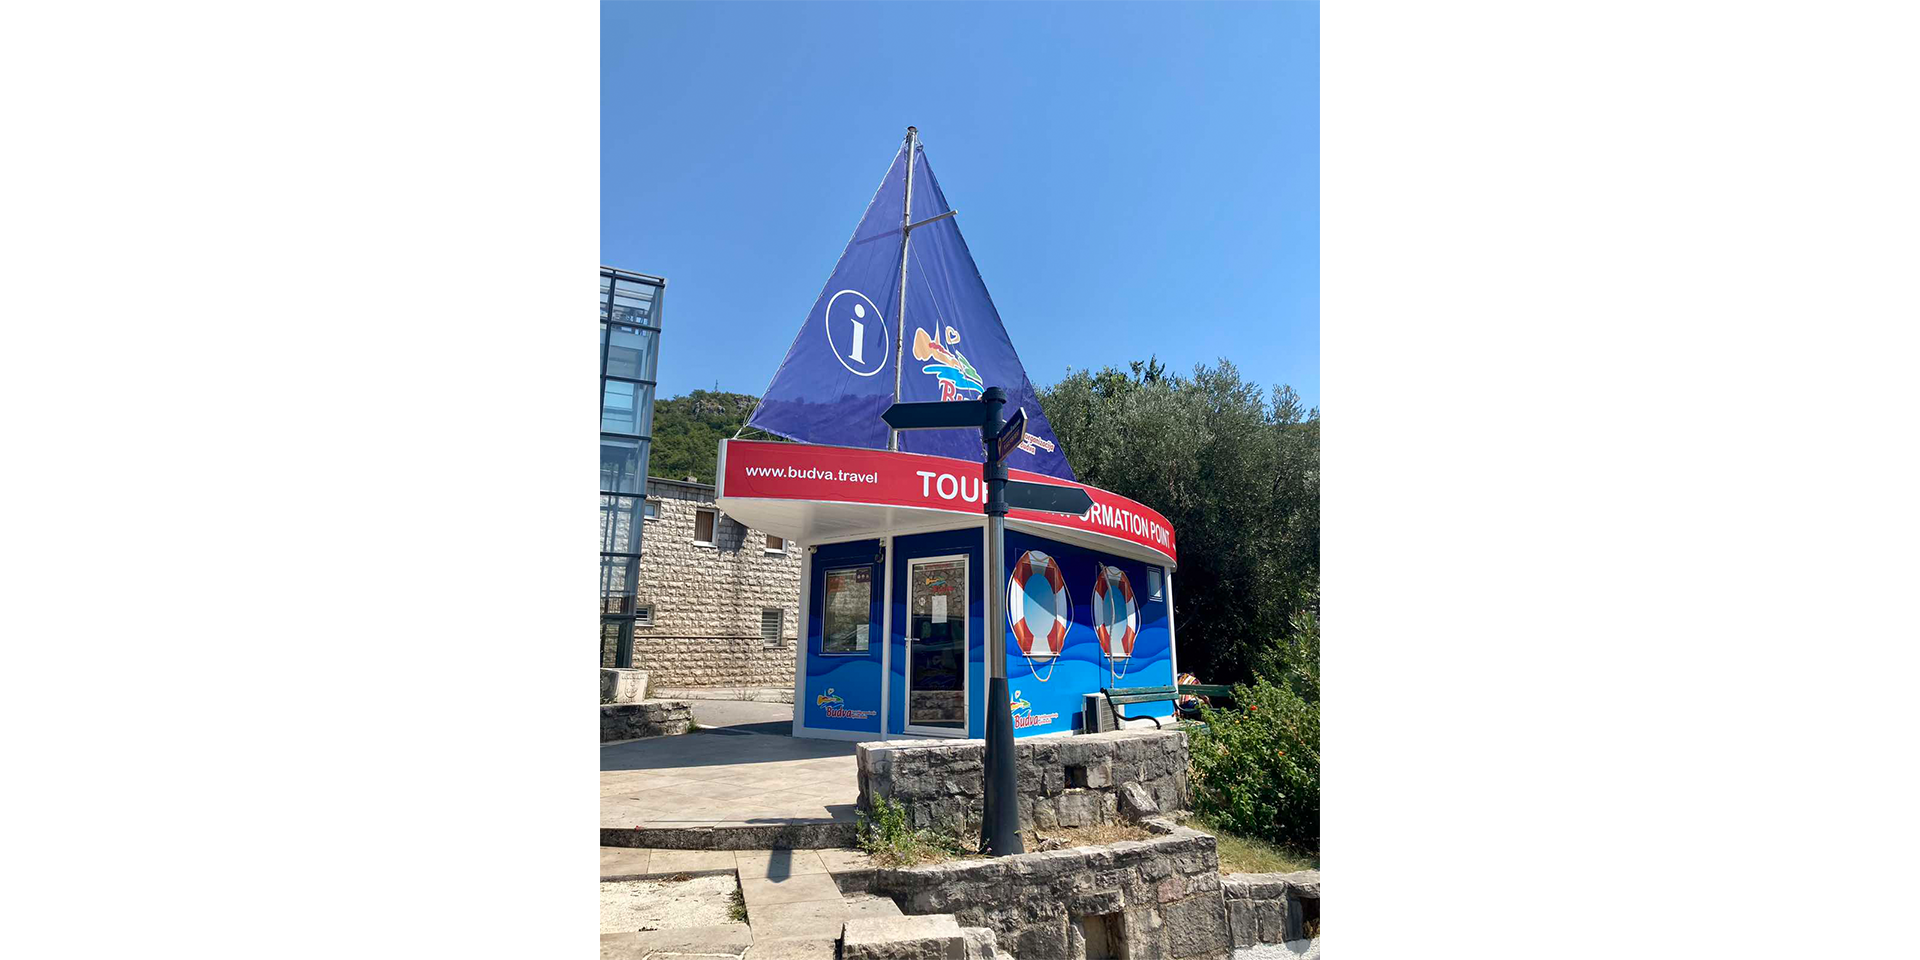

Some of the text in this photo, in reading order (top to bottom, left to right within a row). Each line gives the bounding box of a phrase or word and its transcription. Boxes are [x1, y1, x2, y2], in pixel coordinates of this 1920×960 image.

[745, 466, 878, 483] www.budva.travel
[1045, 502, 1149, 538] RMATION
[1150, 521, 1170, 549] POINT
[826, 706, 852, 718] Budva
[1014, 711, 1038, 729] Budva
